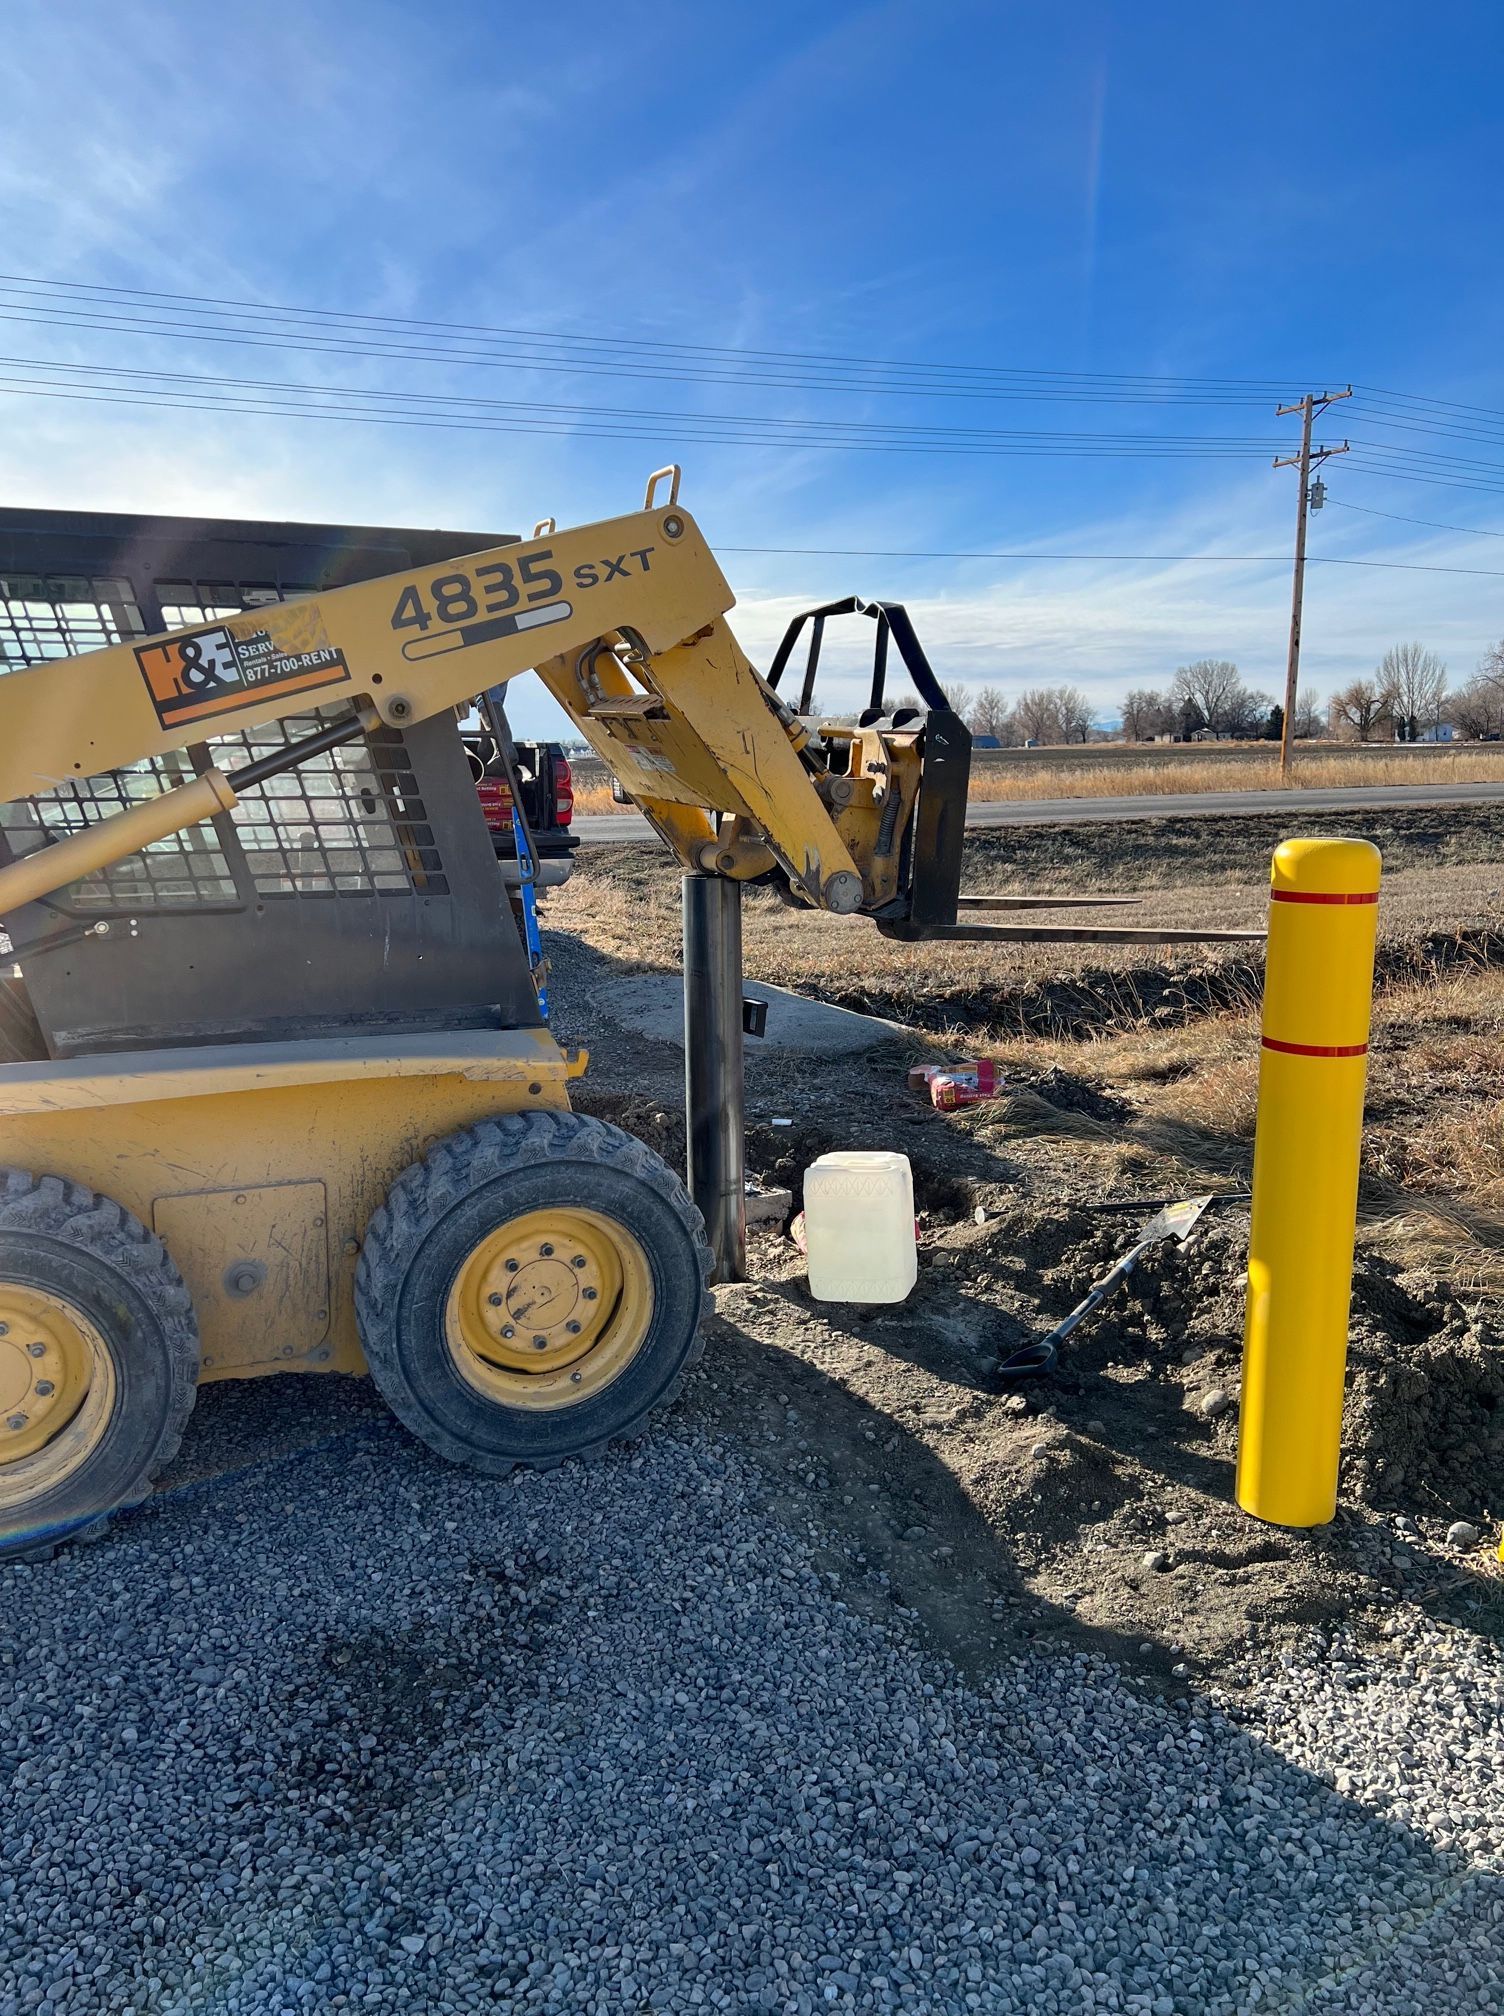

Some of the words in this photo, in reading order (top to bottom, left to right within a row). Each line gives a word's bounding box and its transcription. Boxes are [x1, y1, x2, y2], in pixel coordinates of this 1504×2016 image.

[391, 550, 563, 632] 4835
[573, 547, 656, 589] SXT
[139, 631, 240, 701] H&E
[246, 648, 338, 681] 877-700-RENT
